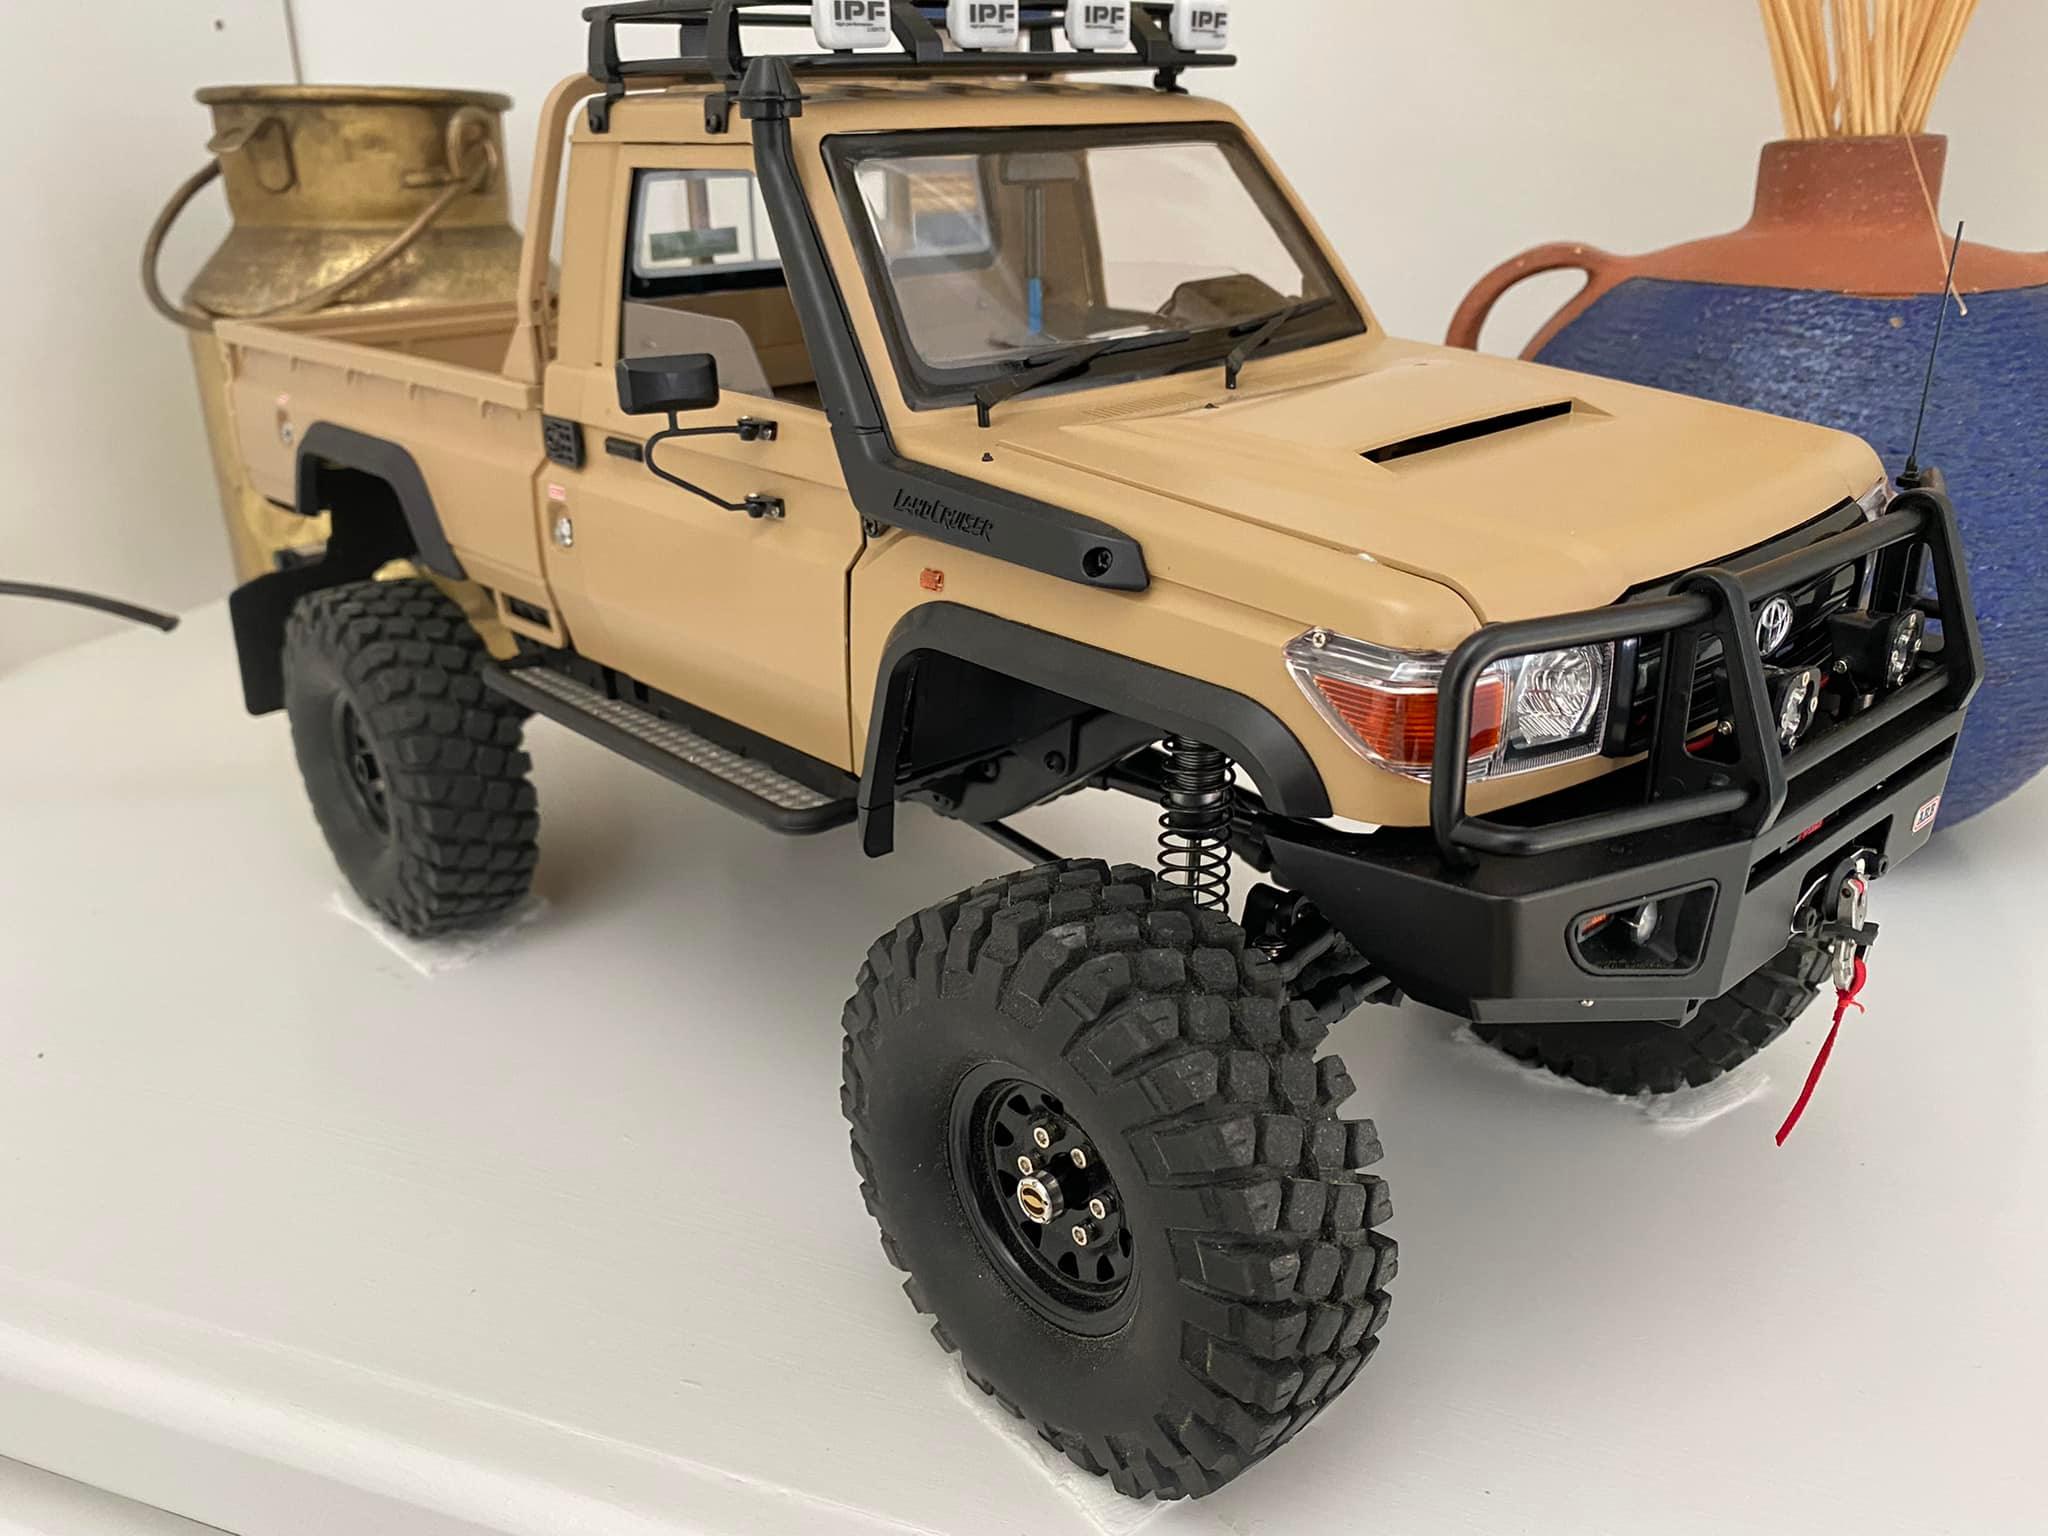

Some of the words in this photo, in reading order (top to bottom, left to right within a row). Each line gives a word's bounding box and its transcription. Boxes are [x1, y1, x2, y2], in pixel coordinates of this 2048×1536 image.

[834, 1, 885, 20] IPF
[970, 4, 1014, 23] IPF
[1085, 6, 1124, 24] IPF
[1192, 11, 1227, 28] IPF
